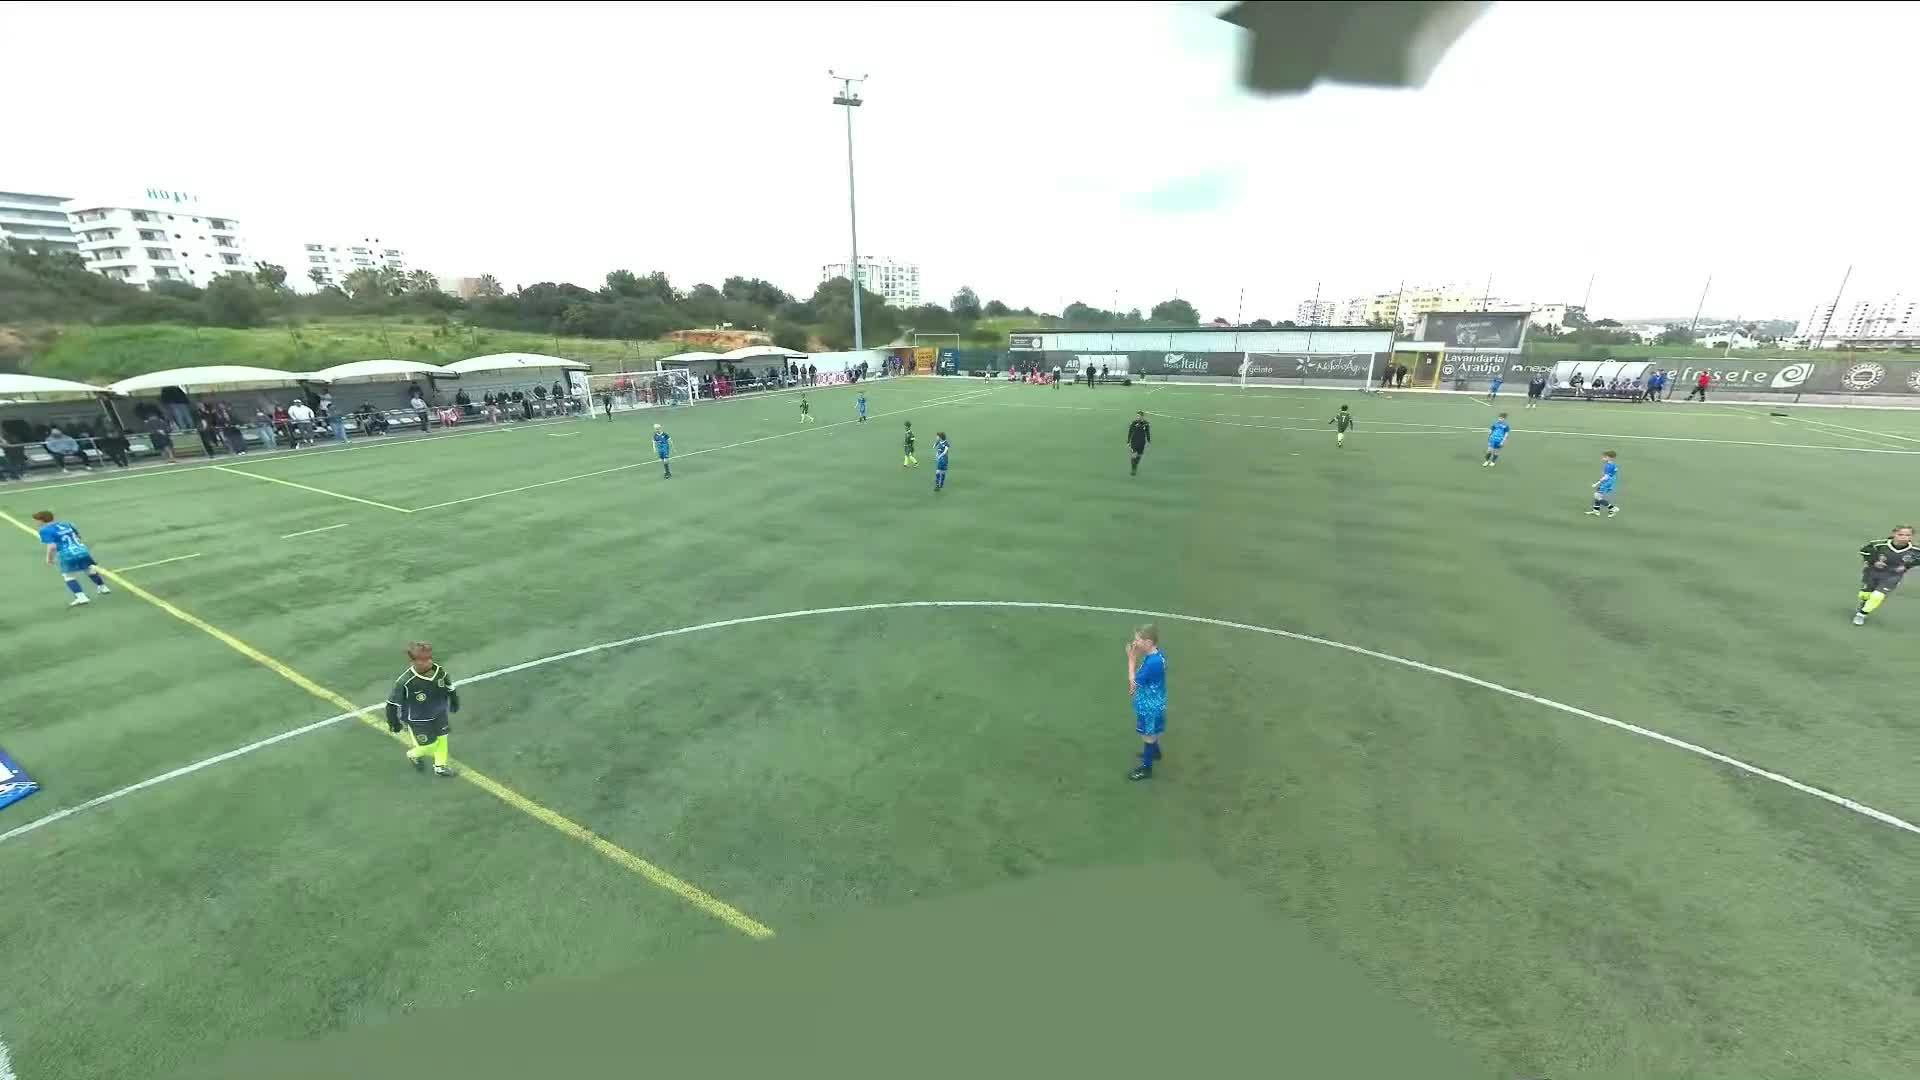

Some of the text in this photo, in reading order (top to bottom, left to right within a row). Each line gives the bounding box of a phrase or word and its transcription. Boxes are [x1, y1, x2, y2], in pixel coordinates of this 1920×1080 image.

[147, 188, 198, 203] HOT
[1444, 353, 1505, 363] Lavandaria
[1458, 362, 1501, 374] Araújo
